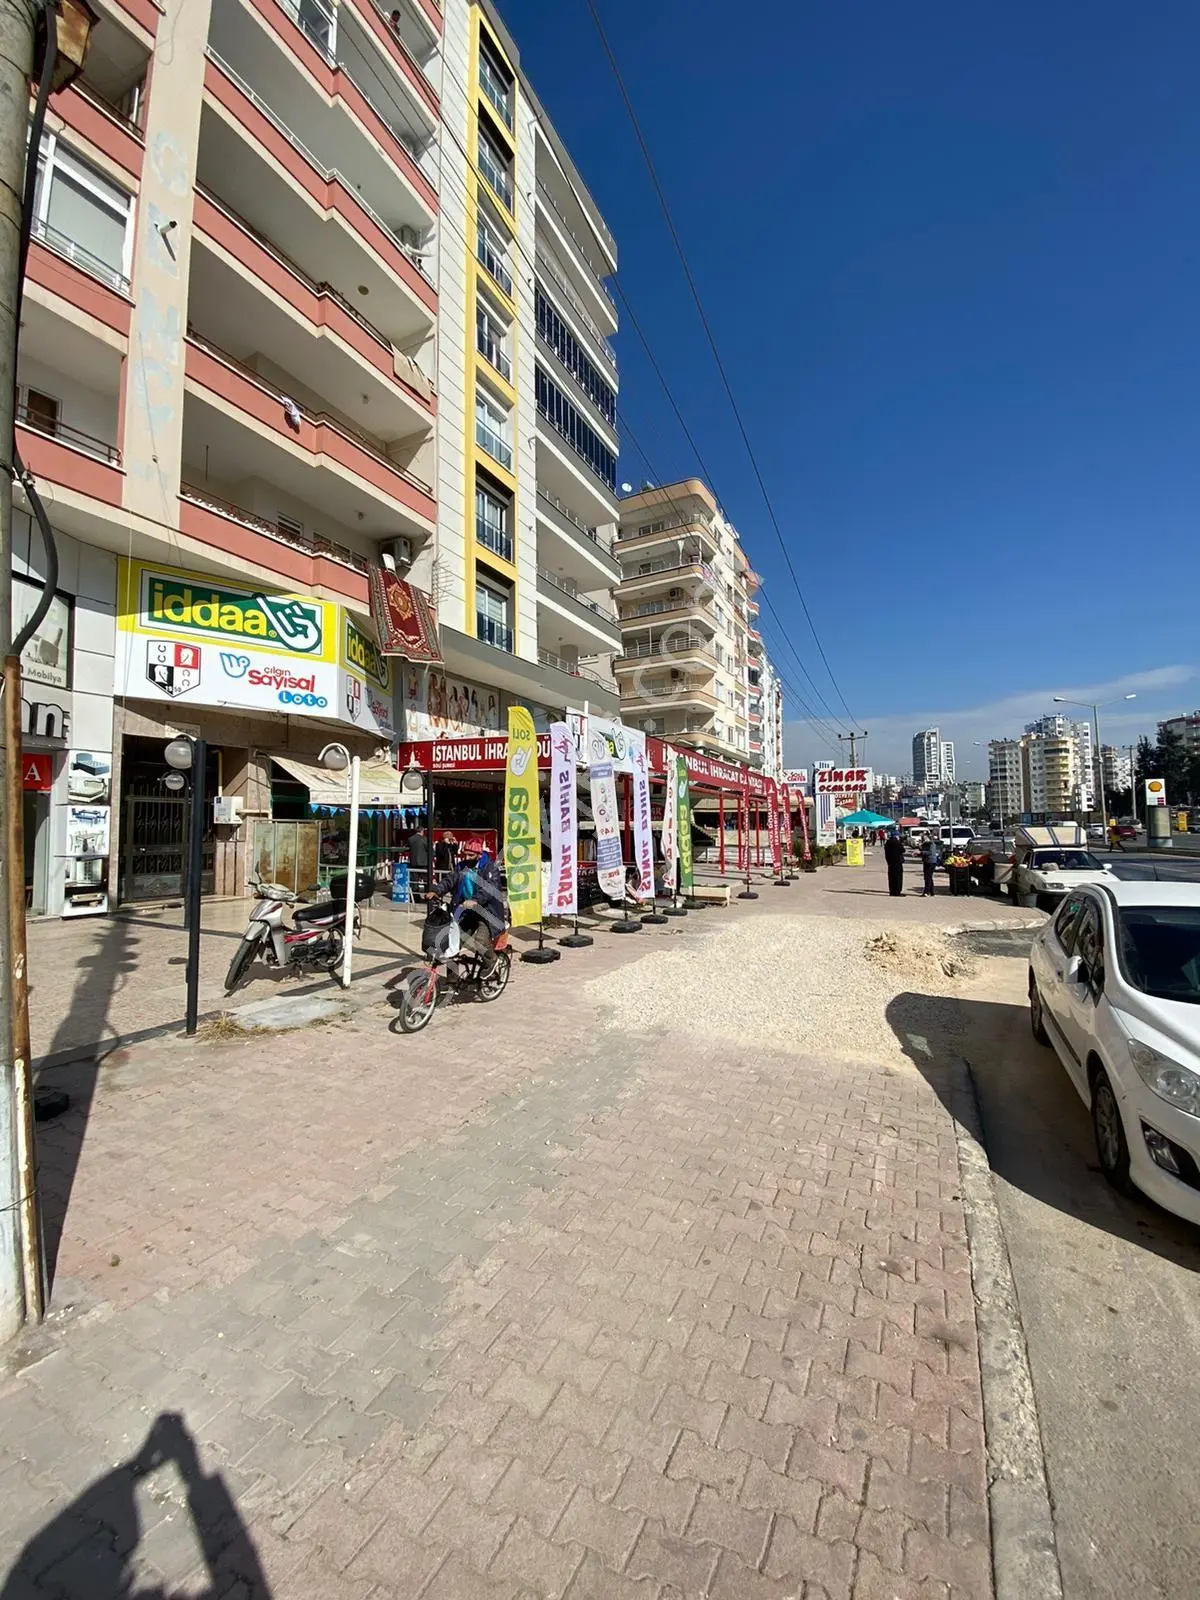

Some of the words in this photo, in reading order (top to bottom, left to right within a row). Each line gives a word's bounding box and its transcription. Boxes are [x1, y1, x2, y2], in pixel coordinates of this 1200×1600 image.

[152, 583, 268, 636] iddaa
[27, 667, 62, 683] Mobilya
[248, 669, 316, 693] Sayısal
[432, 742, 482, 762] İSTANBUL
[485, 738, 508, 760] İHRA
